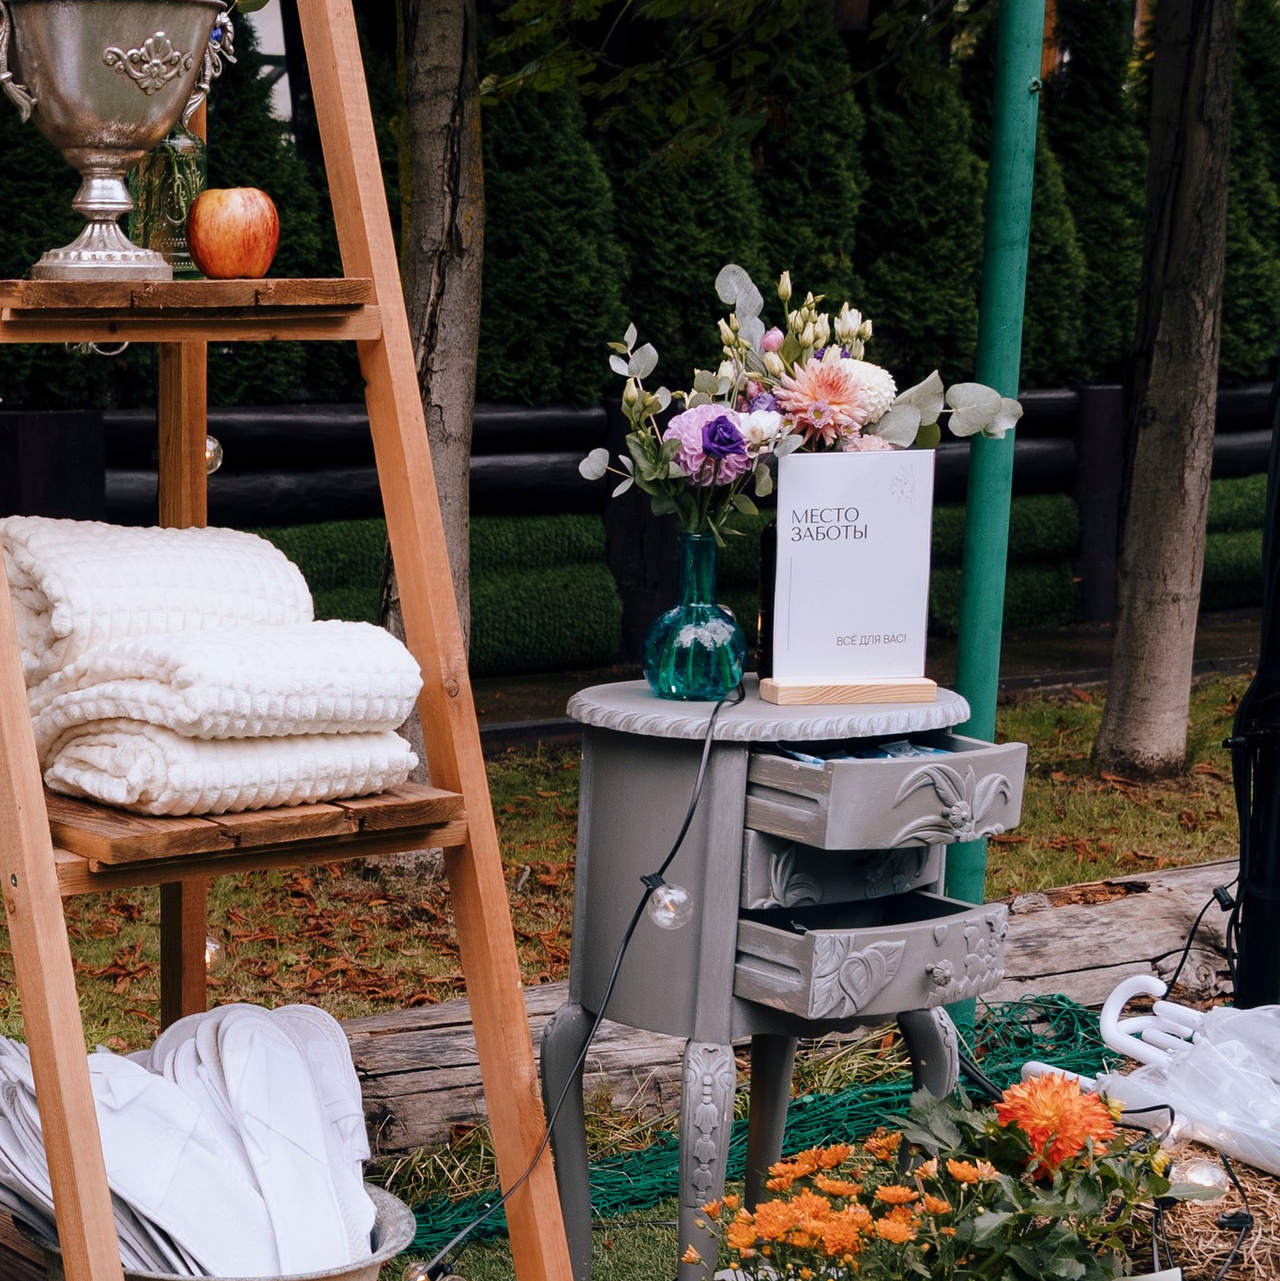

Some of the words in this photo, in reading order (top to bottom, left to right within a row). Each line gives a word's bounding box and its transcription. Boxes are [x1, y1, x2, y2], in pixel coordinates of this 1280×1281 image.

[792, 507, 859, 524] МЕСТО
[791, 524, 867, 542] ЗАБОТЫ
[859, 634, 881, 647] ДЛЯ
[883, 633, 907, 645] ВАС!
